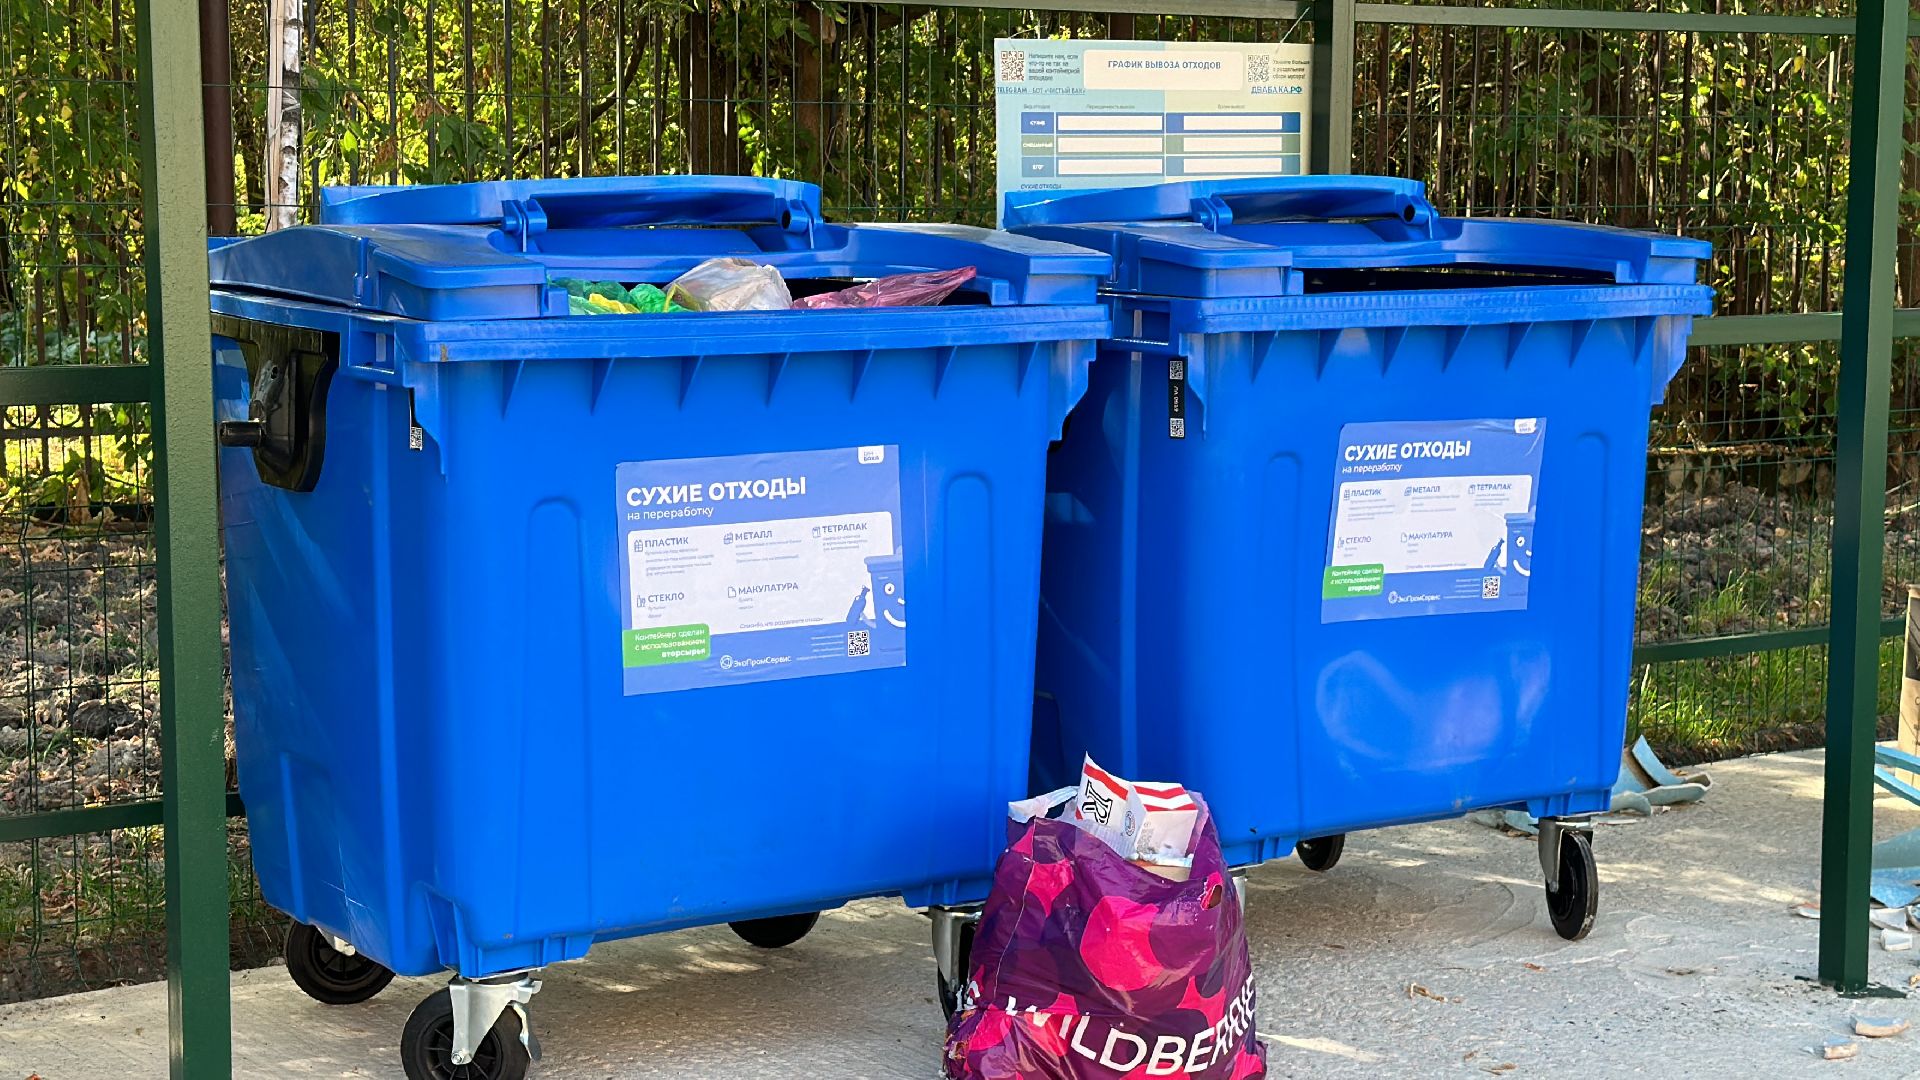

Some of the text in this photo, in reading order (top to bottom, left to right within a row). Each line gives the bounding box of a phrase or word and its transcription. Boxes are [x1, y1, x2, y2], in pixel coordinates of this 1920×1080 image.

[1108, 60, 1221, 70] ГРАФИК ВЫВОЗА ОТХОДОВ
[997, 86, 1027, 94] TELEGRAM
[1251, 86, 1302, 94] ДВАБАКА.РФ
[1344, 440, 1472, 461] СУХИЕ ОТХОДЫ
[1353, 463, 1402, 474] переработку
[626, 476, 806, 506] СУХИЕ ОТХОДЫ
[1412, 486, 1441, 494] МЕТАЛЛ
[1476, 483, 1513, 491] ТЕТРАПАК
[1351, 488, 1382, 497] ПЛАСТИК
[627, 507, 714, 520] на переработку
[821, 523, 868, 533] ТЕТРАПАК
[735, 530, 773, 541] МЕТАЛЛ
[1345, 536, 1372, 544] СТЕКЛО
[1408, 531, 1453, 541] МАКУЛАТУРА
[644, 537, 689, 547] ПЛАСТИК
[738, 582, 799, 595] МАКУЛАТУРА
[647, 592, 685, 602] СТЕКЛО
[634, 629, 705, 642] Контейнер сделан
[641, 639, 706, 651] использованием
[661, 648, 706, 658] вторсырья
[733, 655, 793, 668] ЭкоПромСервис
